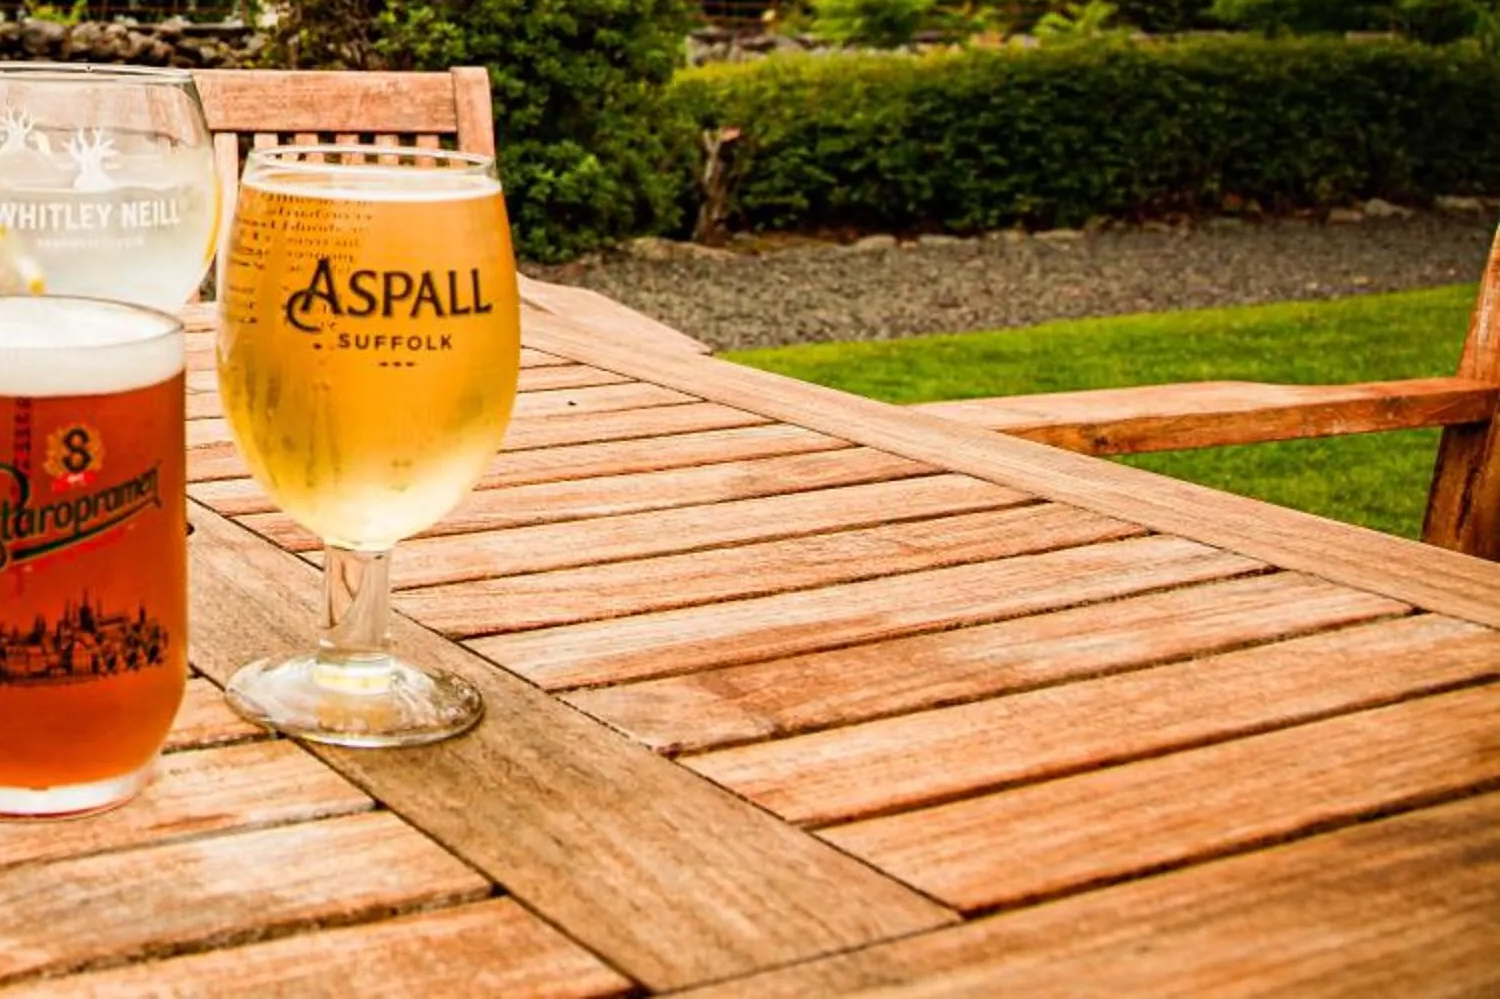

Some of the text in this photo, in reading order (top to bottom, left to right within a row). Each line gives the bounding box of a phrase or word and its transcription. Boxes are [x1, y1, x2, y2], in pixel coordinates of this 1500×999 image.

[120, 197, 180, 229] NEILL
[287, 257, 493, 332] ASPALL
[339, 333, 453, 351] SUFFOLK
